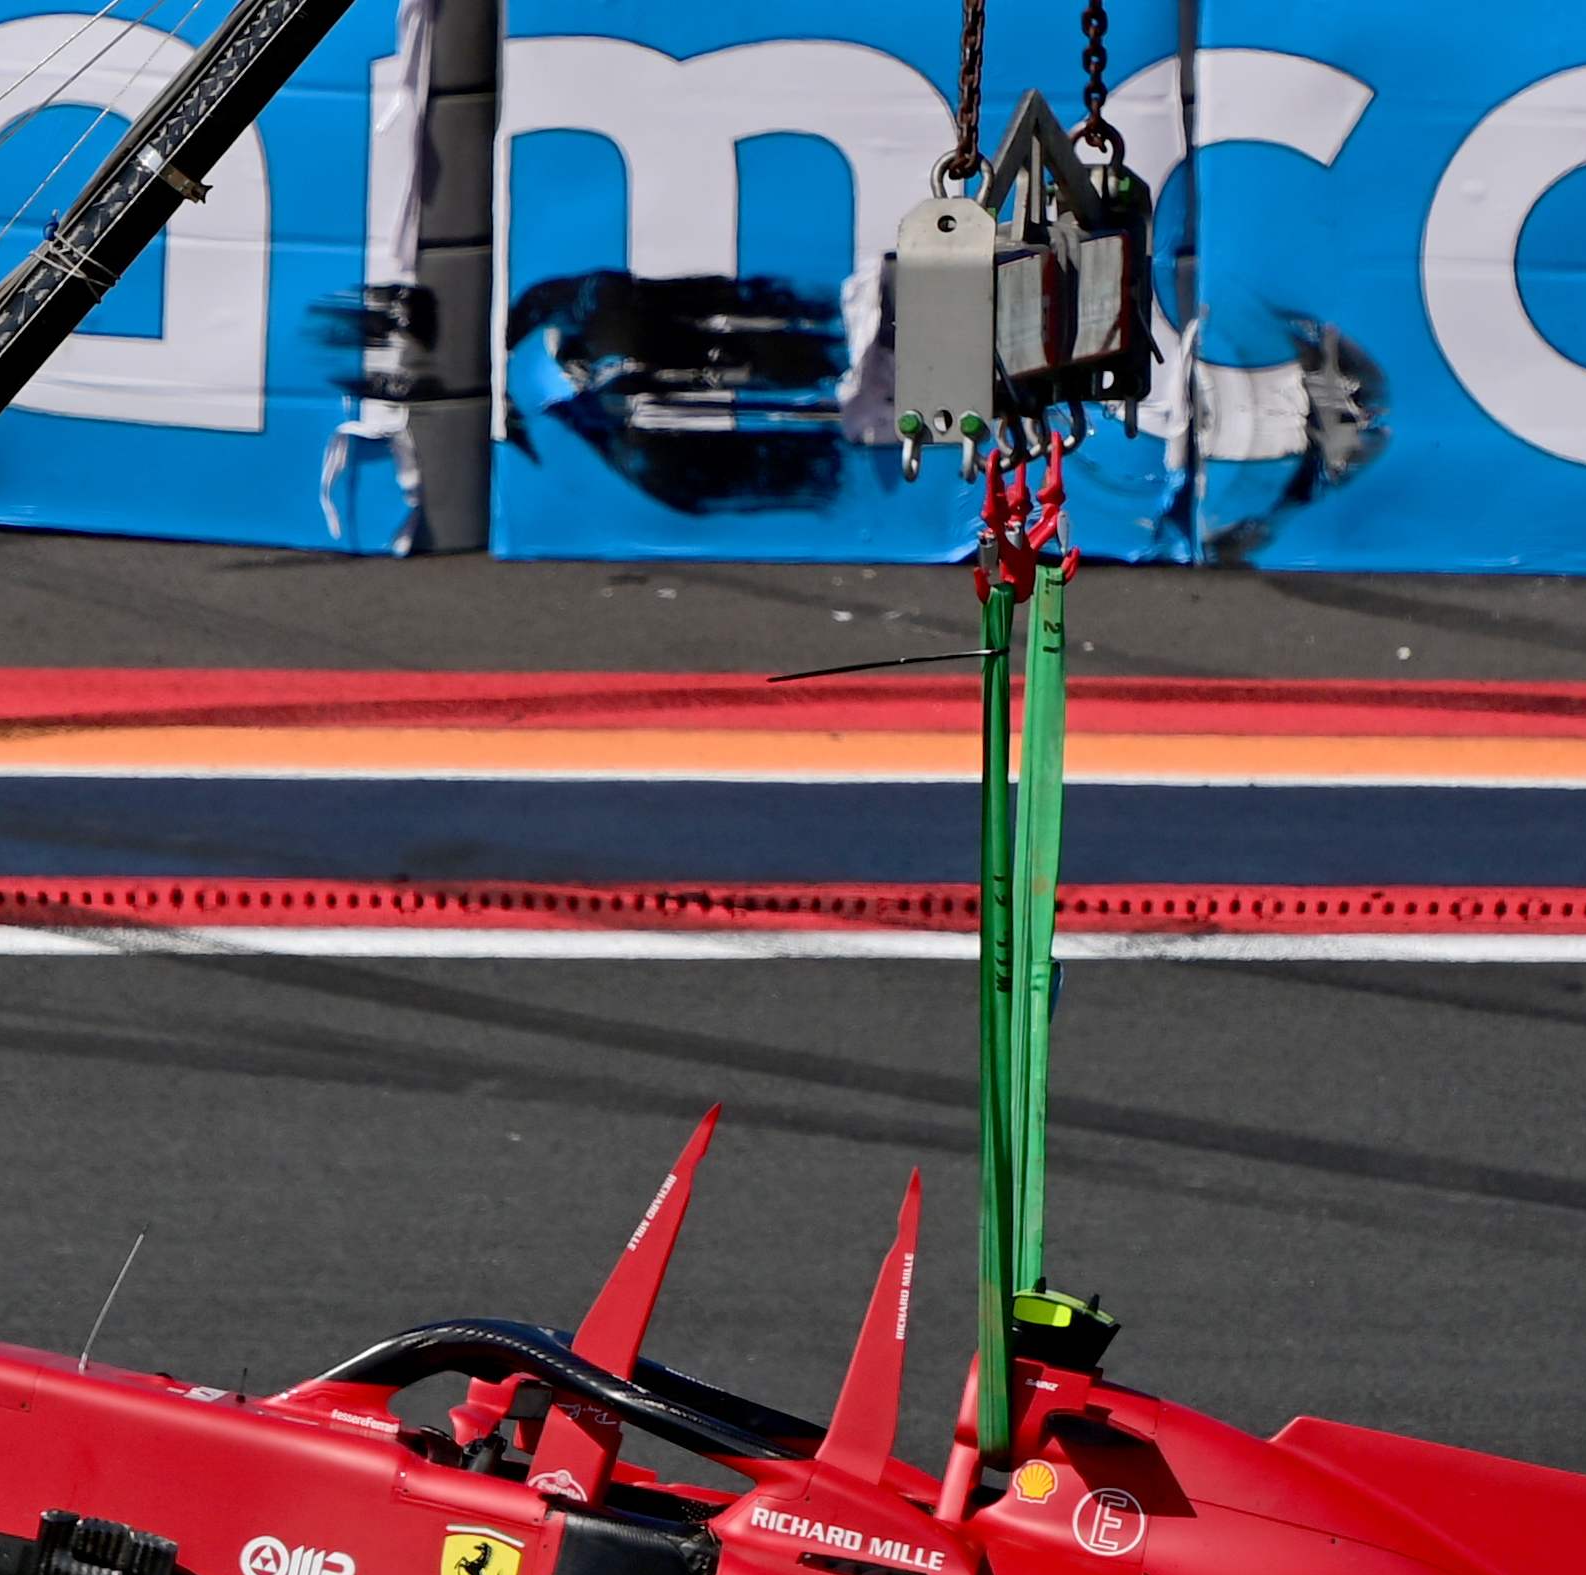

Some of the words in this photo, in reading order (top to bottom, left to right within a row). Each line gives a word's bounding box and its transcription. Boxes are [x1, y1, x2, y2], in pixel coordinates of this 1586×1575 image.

[900, 1252, 915, 1288] MILLE
[895, 1288, 910, 1341] RICHARD
[750, 1506, 864, 1551] RICHARD
[868, 1536, 947, 1571] MILLE
